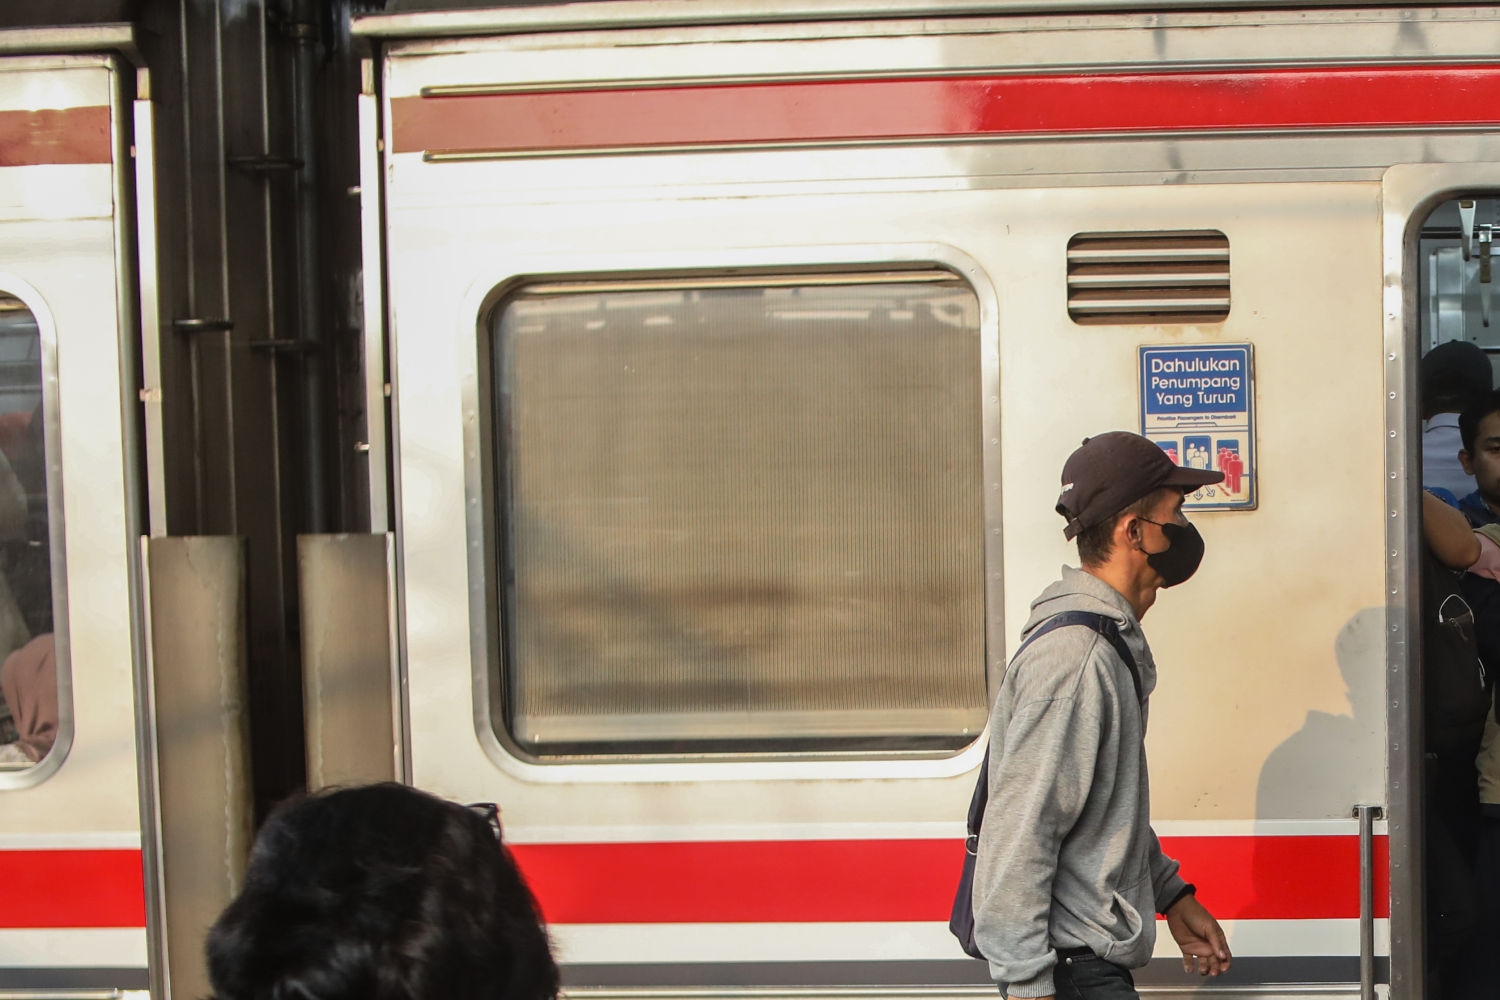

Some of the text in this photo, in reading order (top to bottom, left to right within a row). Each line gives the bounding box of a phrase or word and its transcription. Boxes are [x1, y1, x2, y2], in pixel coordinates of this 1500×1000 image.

[1151, 357, 1239, 373] Dahulukan
[1152, 376, 1240, 390] Penumpang
[1156, 391, 1235, 407] Yang Turun
